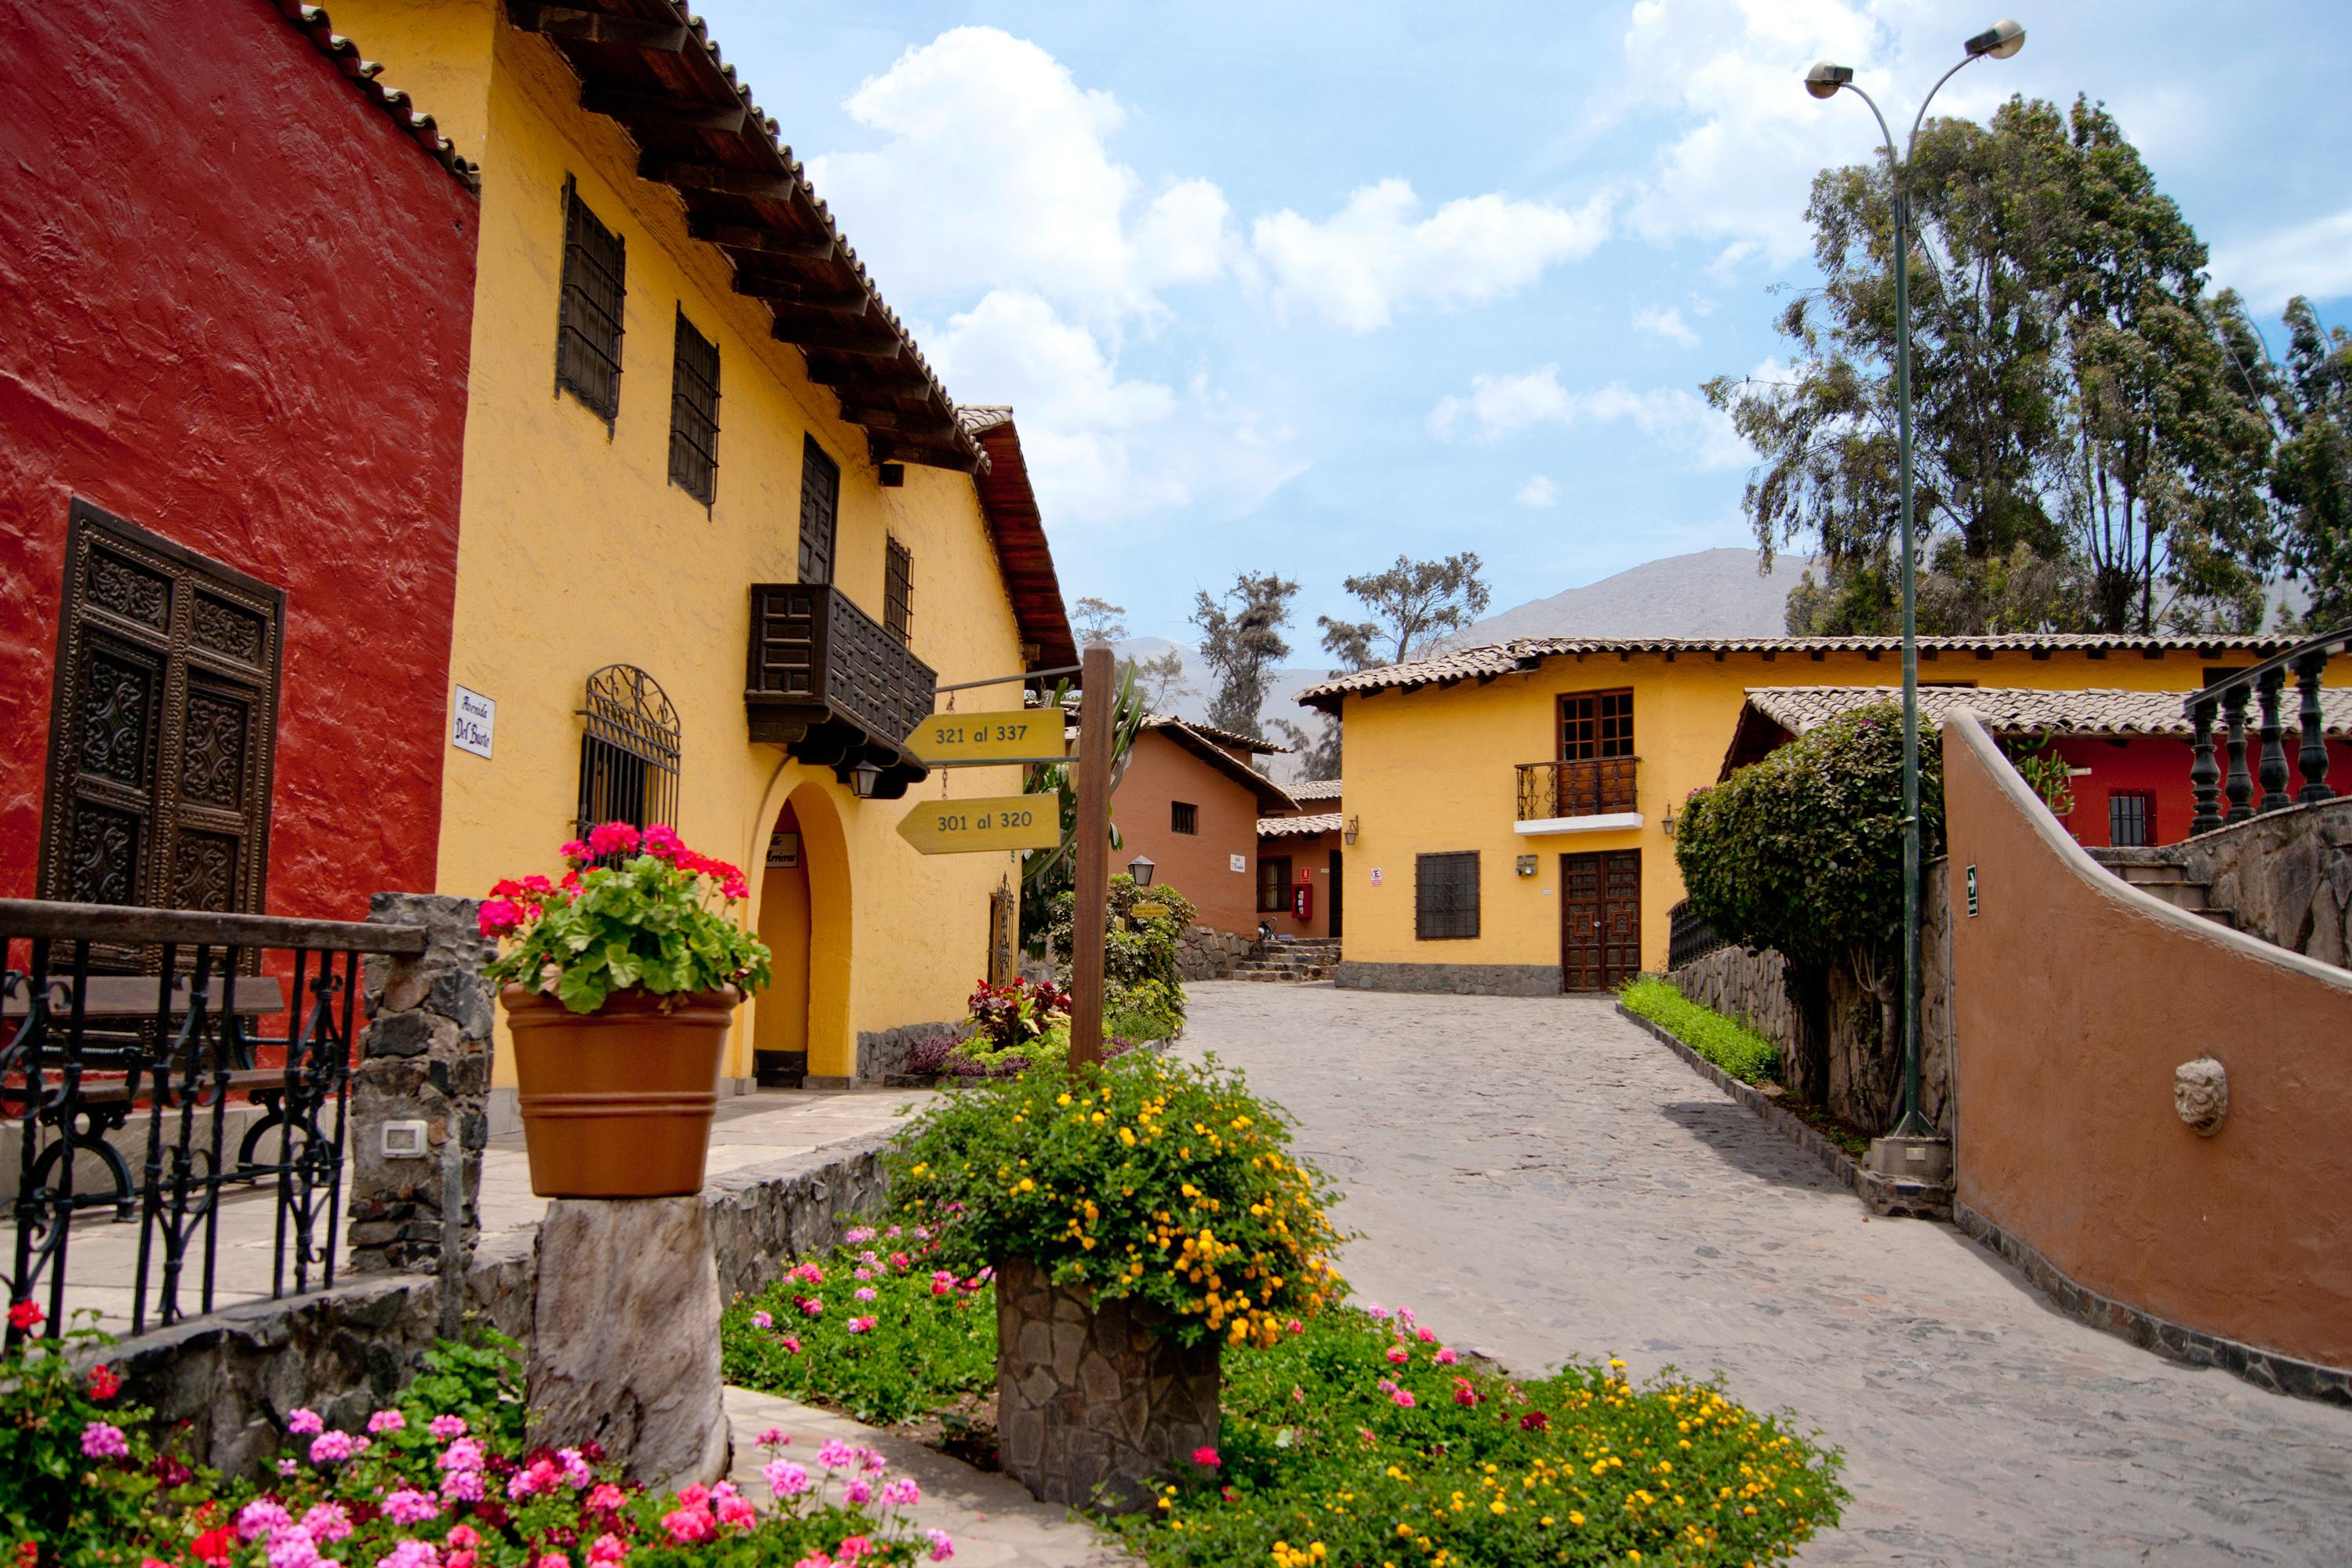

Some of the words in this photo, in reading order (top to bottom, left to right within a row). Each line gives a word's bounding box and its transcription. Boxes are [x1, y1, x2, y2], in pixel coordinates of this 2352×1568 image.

[461, 695, 488, 719] Avenida
[455, 717, 471, 739] Del
[469, 724, 490, 748] Busto
[935, 729, 964, 744] 321
[974, 727, 988, 742] al
[996, 725, 1028, 741] 337
[938, 815, 967, 831] 301
[978, 813, 991, 829] al
[1000, 811, 1032, 827] 320
